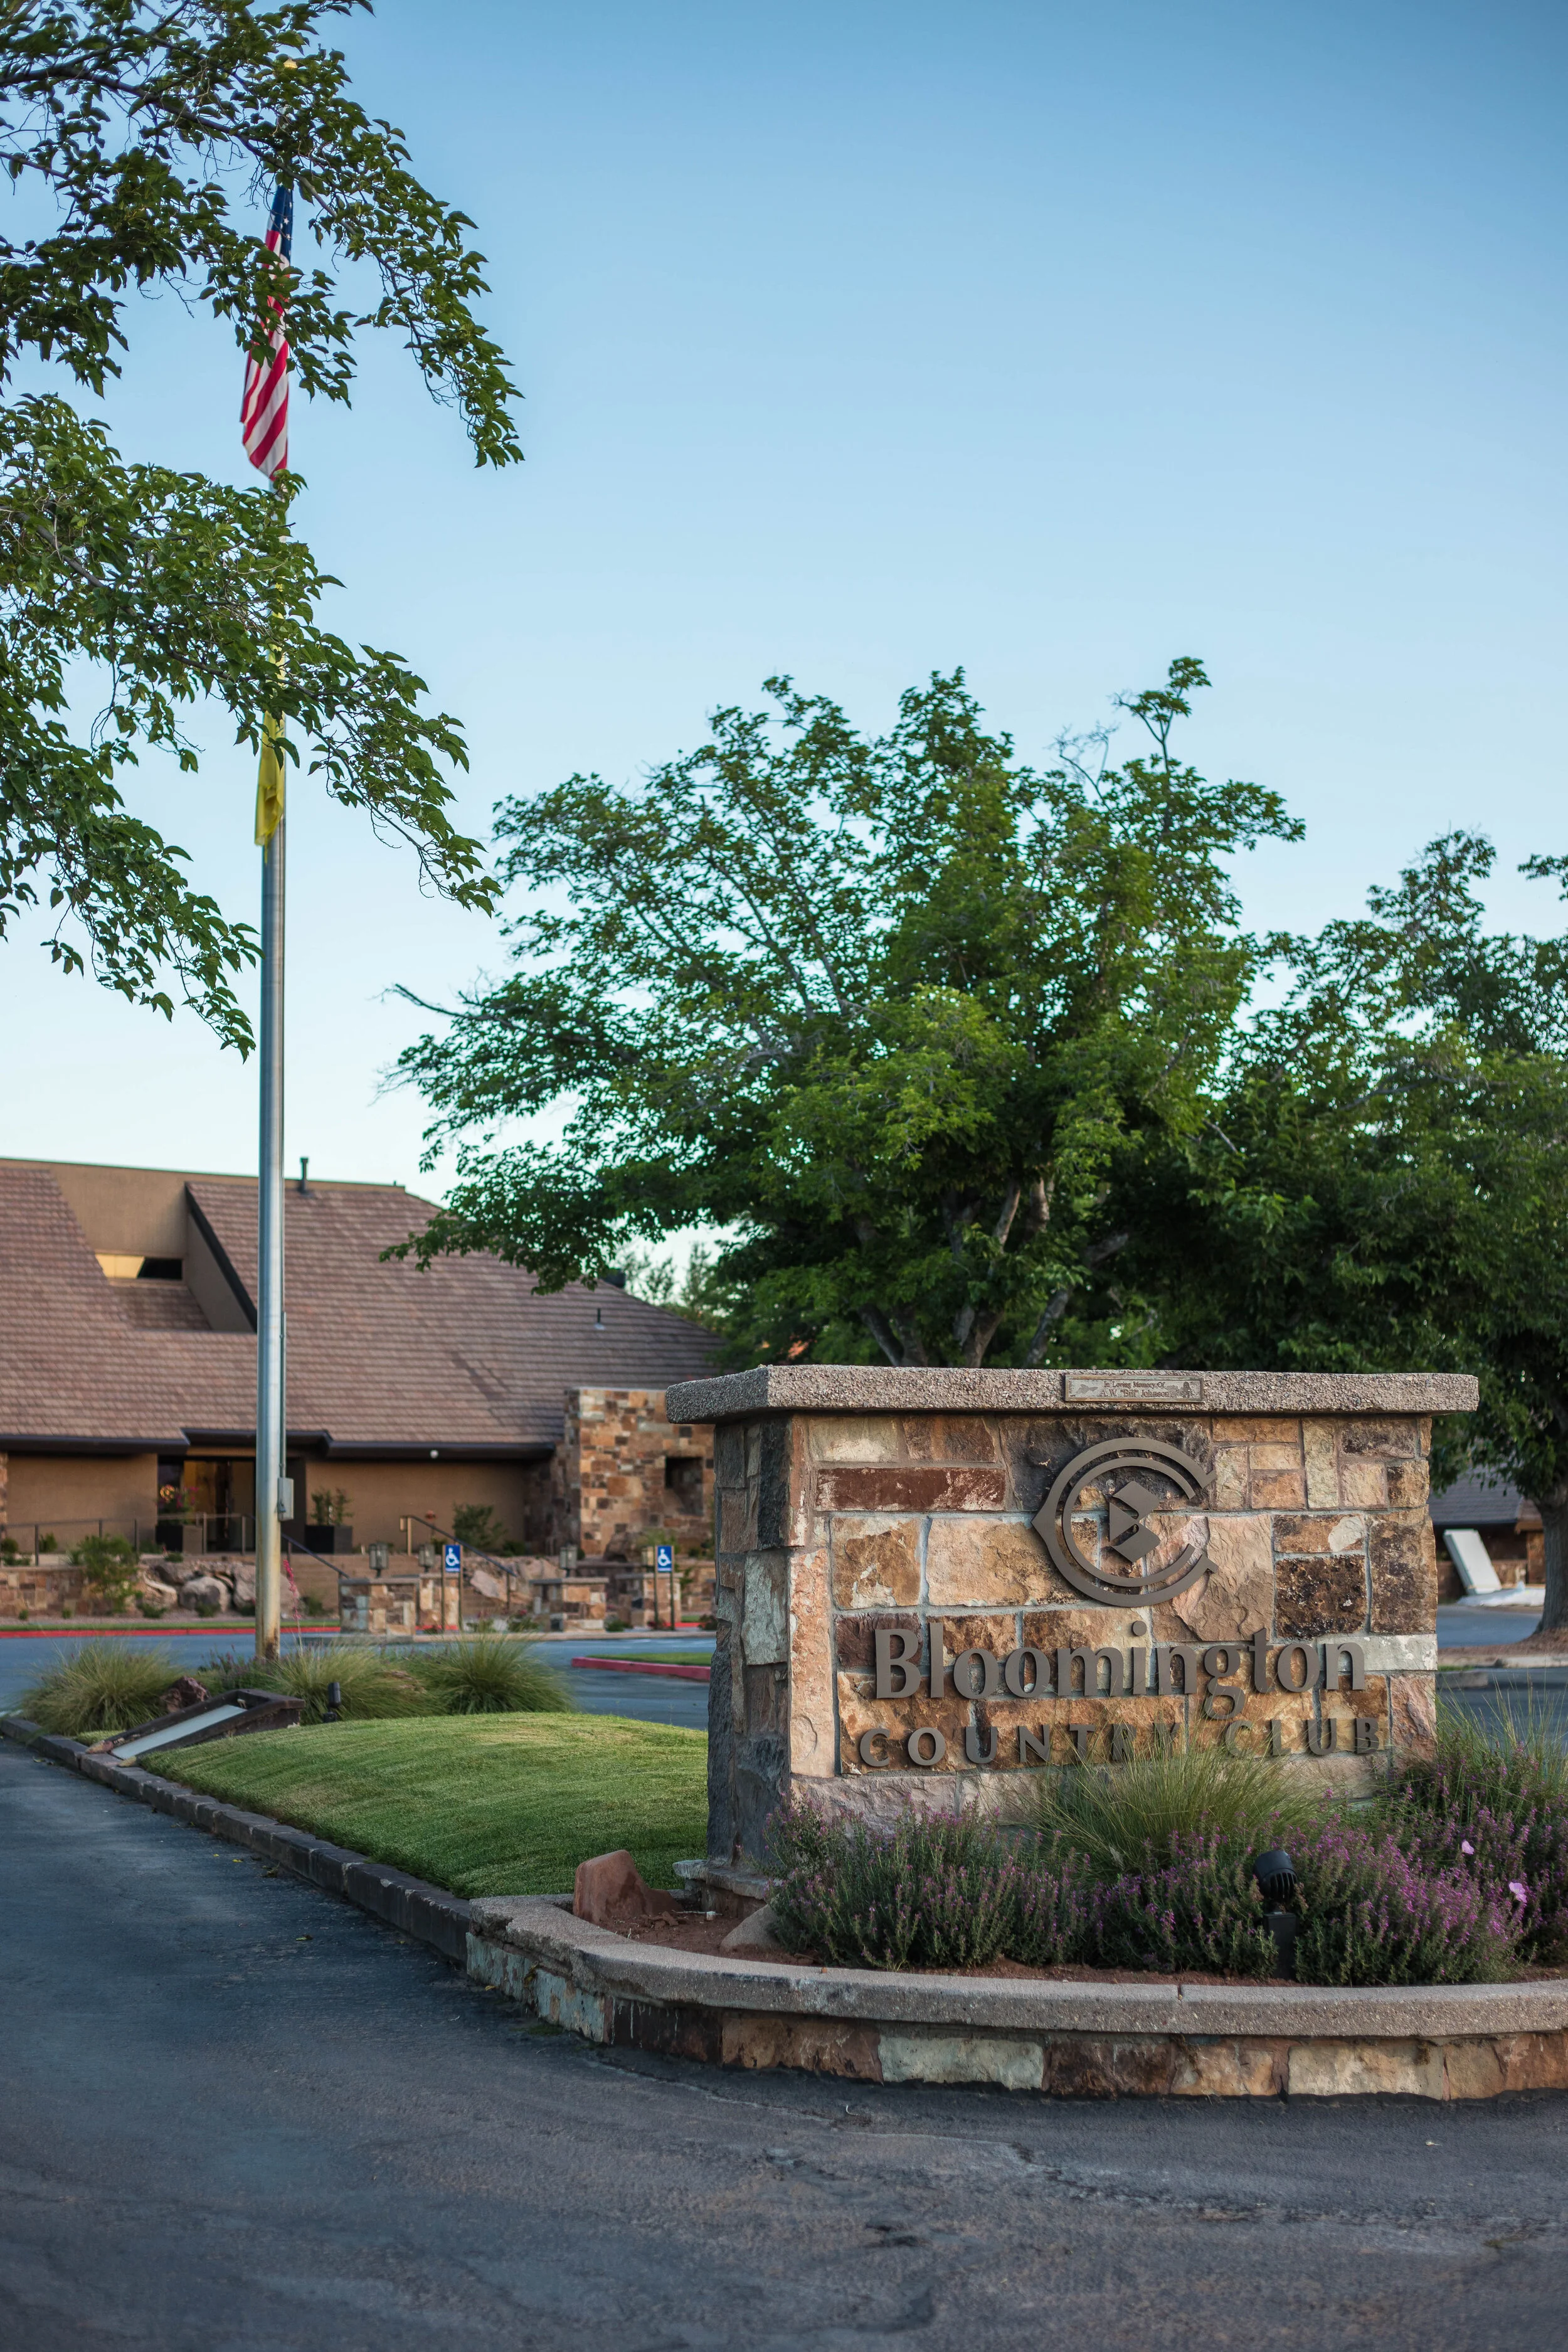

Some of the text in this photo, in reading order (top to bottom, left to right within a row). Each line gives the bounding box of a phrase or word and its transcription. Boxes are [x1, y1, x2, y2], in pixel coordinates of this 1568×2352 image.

[1112, 1380, 1131, 1389] Loving
[1133, 1381, 1155, 1389] Memory
[1140, 1389, 1170, 1397] Johnson
[876, 1621, 1365, 1720] Bloomington
[859, 1717, 1380, 1767] COUNTRY CLUB
